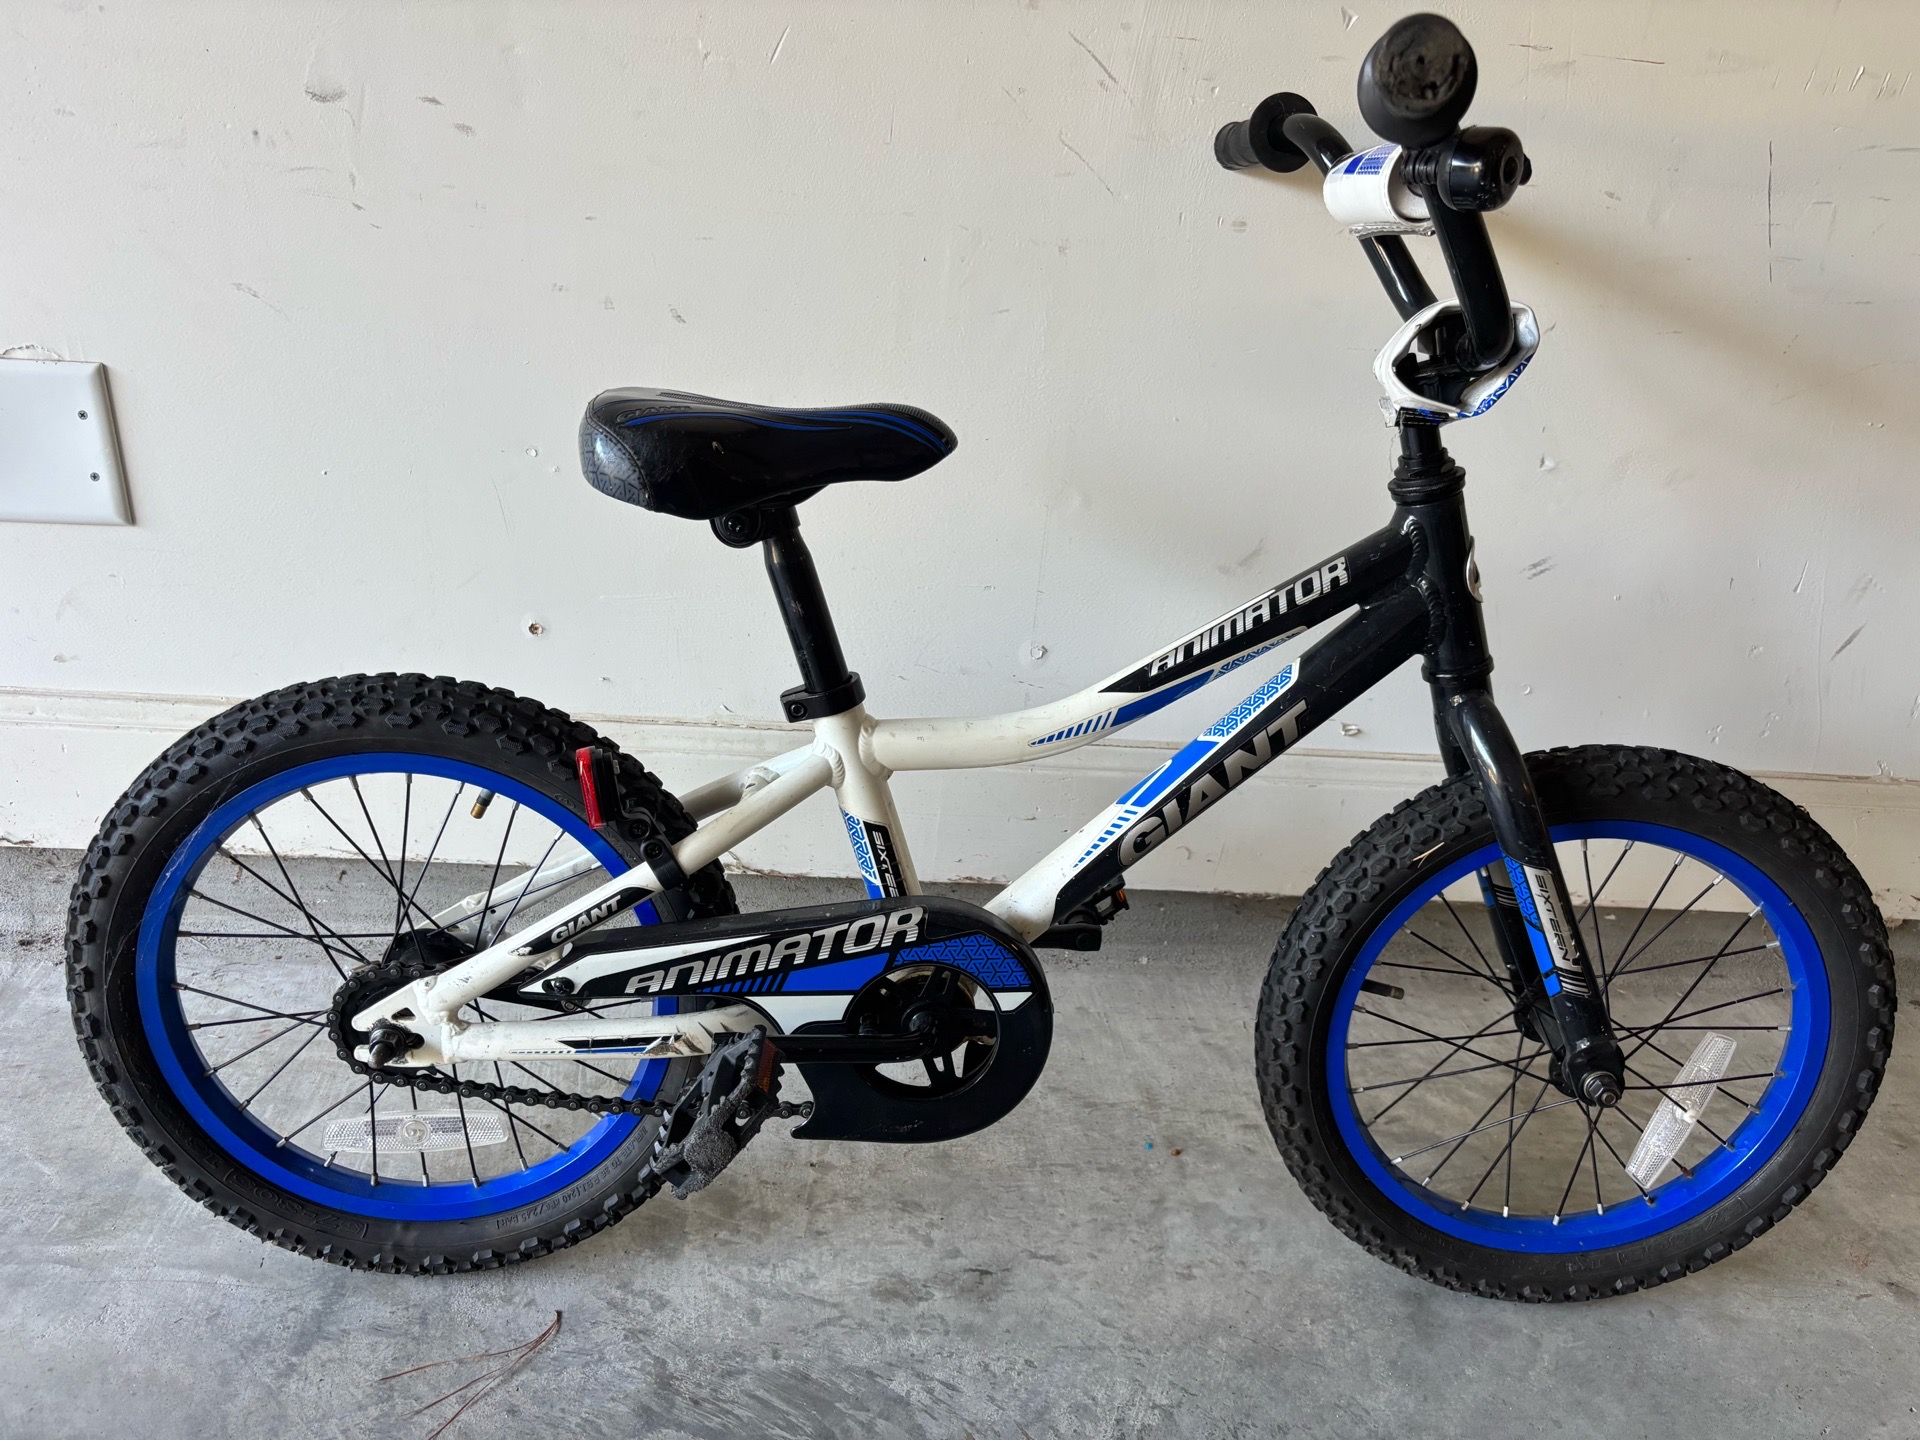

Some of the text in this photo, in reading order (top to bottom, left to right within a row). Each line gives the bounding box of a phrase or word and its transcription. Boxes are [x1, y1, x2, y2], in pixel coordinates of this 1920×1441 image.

[1149, 556, 1349, 677] ANIMATOR
[1119, 699, 1308, 867] GIANT
[872, 830, 900, 898] SIXTEE
[551, 895, 621, 944] GIANT
[624, 906, 925, 995] ANIMATOR
[1535, 873, 1571, 962] SIXTEEN
